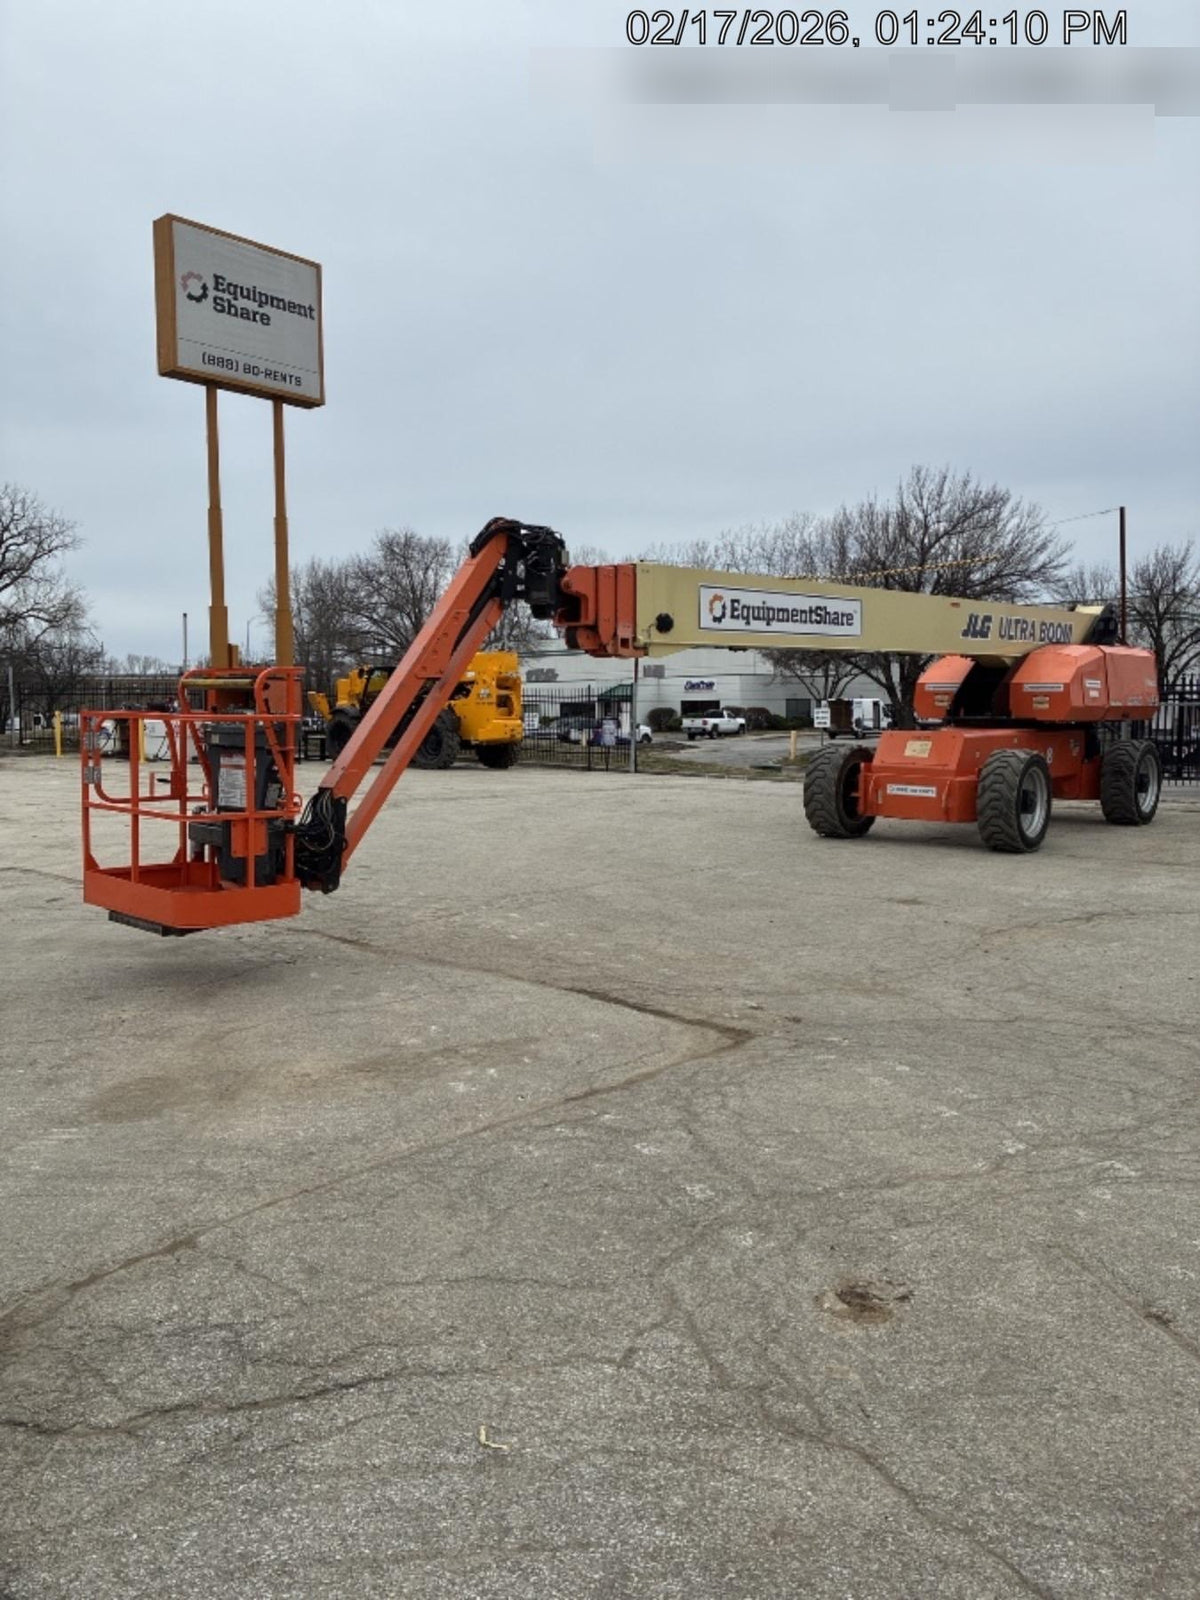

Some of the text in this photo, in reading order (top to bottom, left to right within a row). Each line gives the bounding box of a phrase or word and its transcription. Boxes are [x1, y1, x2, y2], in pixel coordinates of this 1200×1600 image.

[213, 273, 316, 321] Equipment
[213, 296, 272, 326] Share
[201, 351, 239, 372] (888)
[730, 599, 855, 626] EquipmentShare
[961, 613, 1073, 643] JLG ULTRA BOOM
